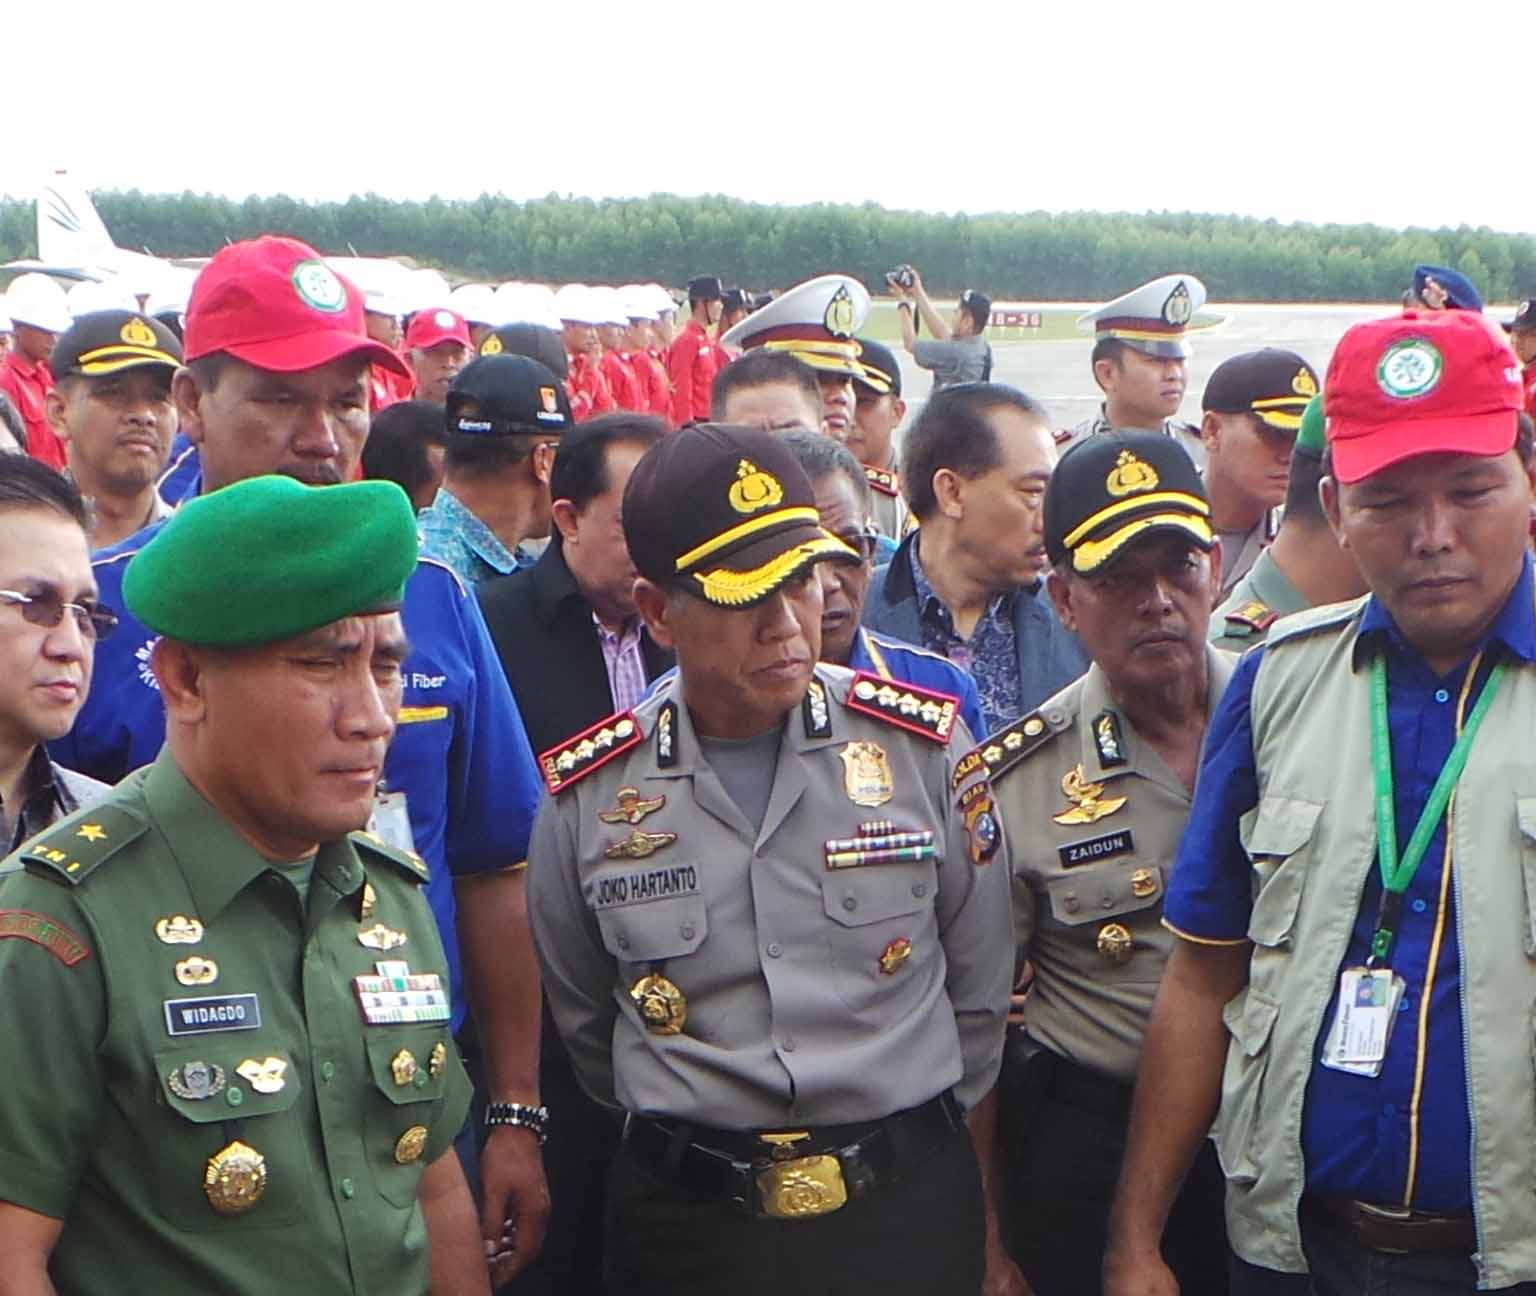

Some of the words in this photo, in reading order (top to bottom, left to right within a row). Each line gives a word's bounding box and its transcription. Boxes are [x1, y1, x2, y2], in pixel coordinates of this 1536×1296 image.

[412, 672, 447, 689] Fiber
[31, 844, 81, 873] TNI
[1069, 837, 1124, 861] ZAIDUN
[596, 876, 628, 905] JOKO
[630, 865, 697, 899] HARTANTO
[181, 1004, 246, 1024] WIDAGDO
